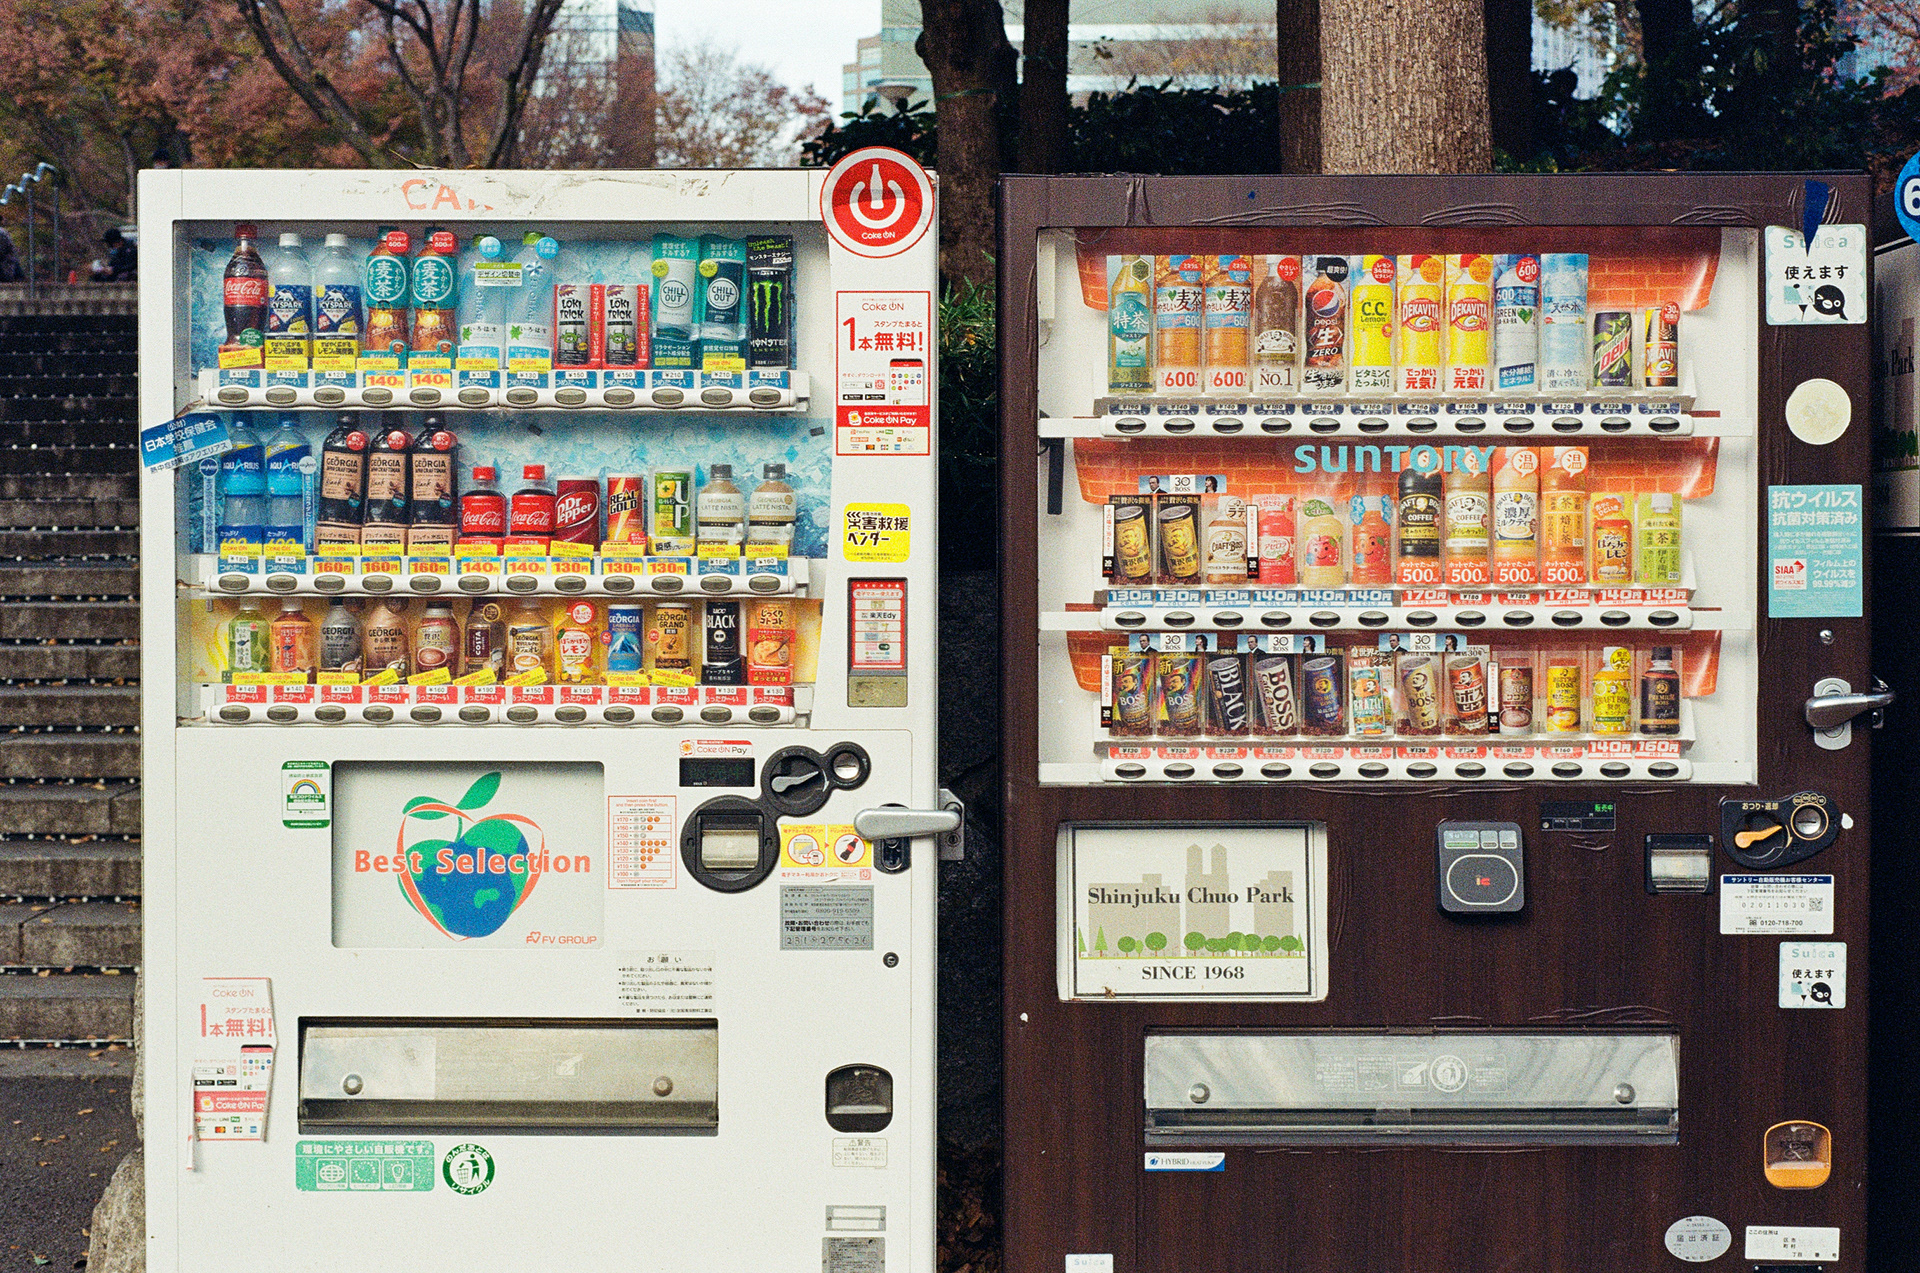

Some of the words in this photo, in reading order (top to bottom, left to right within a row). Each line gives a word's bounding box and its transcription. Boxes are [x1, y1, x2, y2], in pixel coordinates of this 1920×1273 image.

[1518, 265, 1537, 276] 600
[1785, 266, 1848, 280] 使えます
[376, 261, 394, 297] 麦茶
[421, 262, 440, 297] 麦茶
[225, 280, 261, 296] Coca-Cola
[663, 286, 686, 296] CHILL
[712, 286, 734, 295] CHILL
[665, 294, 682, 302] OUT
[714, 294, 731, 302] OUT
[1496, 289, 1514, 300] 600
[562, 299, 582, 308] LOKI
[610, 298, 630, 308] LOKI
[862, 302, 887, 311] Coke
[888, 302, 904, 311] ON
[1176, 290, 1202, 312] 麦茶
[1362, 301, 1387, 316] C.C.
[1403, 304, 1440, 320] DEKAVITA
[1451, 302, 1488, 323] DEKAVITA
[1551, 302, 1581, 314] 天然水
[560, 310, 584, 320] TRICK
[608, 310, 632, 320] TRICK
[1114, 312, 1148, 328] 特茶
[1315, 318, 1338, 326] pepsi
[1315, 327, 1335, 346] 生
[1313, 348, 1339, 357] ZERO
[1165, 372, 1195, 387] 600
[1214, 372, 1244, 387] 600
[1260, 368, 1294, 386] NO.1
[1356, 370, 1390, 378] ビタミンC
[1355, 379, 1390, 388] たっぷり!
[1406, 378, 1436, 390] 元気!
[1454, 377, 1484, 389] 元気!
[864, 416, 885, 424] Coke
[900, 417, 917, 426] Pay
[144, 419, 217, 452] 日本学校保健会
[223, 459, 260, 474] AQUARIUS
[326, 456, 358, 467] GEORGIA
[1518, 453, 1534, 469] 温
[1567, 453, 1583, 469] 温
[1175, 477, 1190, 486] 30
[610, 490, 637, 504] REAL
[1772, 491, 1858, 508] 抗ウイルス
[565, 496, 582, 511] Dr
[610, 499, 637, 515] GOLD
[512, 510, 550, 526] Coca-Cola
[557, 502, 592, 524] Pepper
[1504, 507, 1530, 518] 濃厚
[463, 511, 500, 526] Coca-Cola
[848, 517, 909, 531] 災害救援
[1496, 519, 1532, 527] ミルクティー
[1772, 512, 1858, 526] 抗菌対策済み
[1561, 515, 1570, 544] 焙じ茶
[848, 533, 890, 546] ベンダー
[1658, 533, 1669, 544] 茶
[1606, 550, 1627, 558] レモン
[316, 563, 350, 572] 160円
[363, 562, 398, 572] 160円
[411, 562, 446, 572] 160円
[464, 563, 500, 572] 140円
[554, 563, 588, 572] 130円
[606, 563, 640, 572] 130円
[650, 563, 684, 573] 130円
[1775, 566, 1794, 574] SIAA
[1402, 569, 1438, 583] 500ml
[1451, 569, 1488, 583] 500ml
[1813, 570, 1856, 578] ウイルスを
[1110, 591, 1152, 601] 130円
[1158, 591, 1199, 601] 130円
[1207, 591, 1250, 601] 150円
[1256, 591, 1297, 601] 140円
[1302, 591, 1344, 601] 140円
[1350, 591, 1392, 601] 140円
[1406, 590, 1447, 600] 170円
[1548, 590, 1589, 600] 170円
[1601, 590, 1643, 600] 140円
[1646, 590, 1687, 600] 140円
[608, 615, 640, 623] GEORGIA
[657, 613, 688, 622] GEORGIA
[707, 614, 736, 628] BLACK
[1273, 636, 1289, 645] 30
[1415, 636, 1430, 644] 30
[562, 646, 589, 654] レモン
[1119, 694, 1146, 706] BOSS
[1168, 694, 1194, 706] BOSS
[1217, 663, 1247, 730] BLACK
[1268, 668, 1294, 728] BOSS
[1409, 694, 1436, 707] BOSS
[732, 747, 747, 755] Pay
[1592, 742, 1631, 752] 140円
[1638, 741, 1679, 752] 160円
[354, 849, 423, 874] Best
[436, 848, 590, 874] Selection
[1088, 887, 1180, 908] Shinjuku
[1187, 887, 1239, 904] Chuo
[1246, 887, 1294, 904] Park
[542, 936, 556, 944] FV
[558, 936, 597, 944] GROUP
[1141, 966, 1196, 980] SINCE
[1203, 966, 1245, 980] 1968
[1792, 969, 1834, 979] 使えます
[213, 988, 237, 998] Coke
[216, 1102, 237, 1110] Coke
[302, 1144, 430, 1155] 環境にやさしい自販機です。
[450, 1178, 491, 1195] リサイクル
